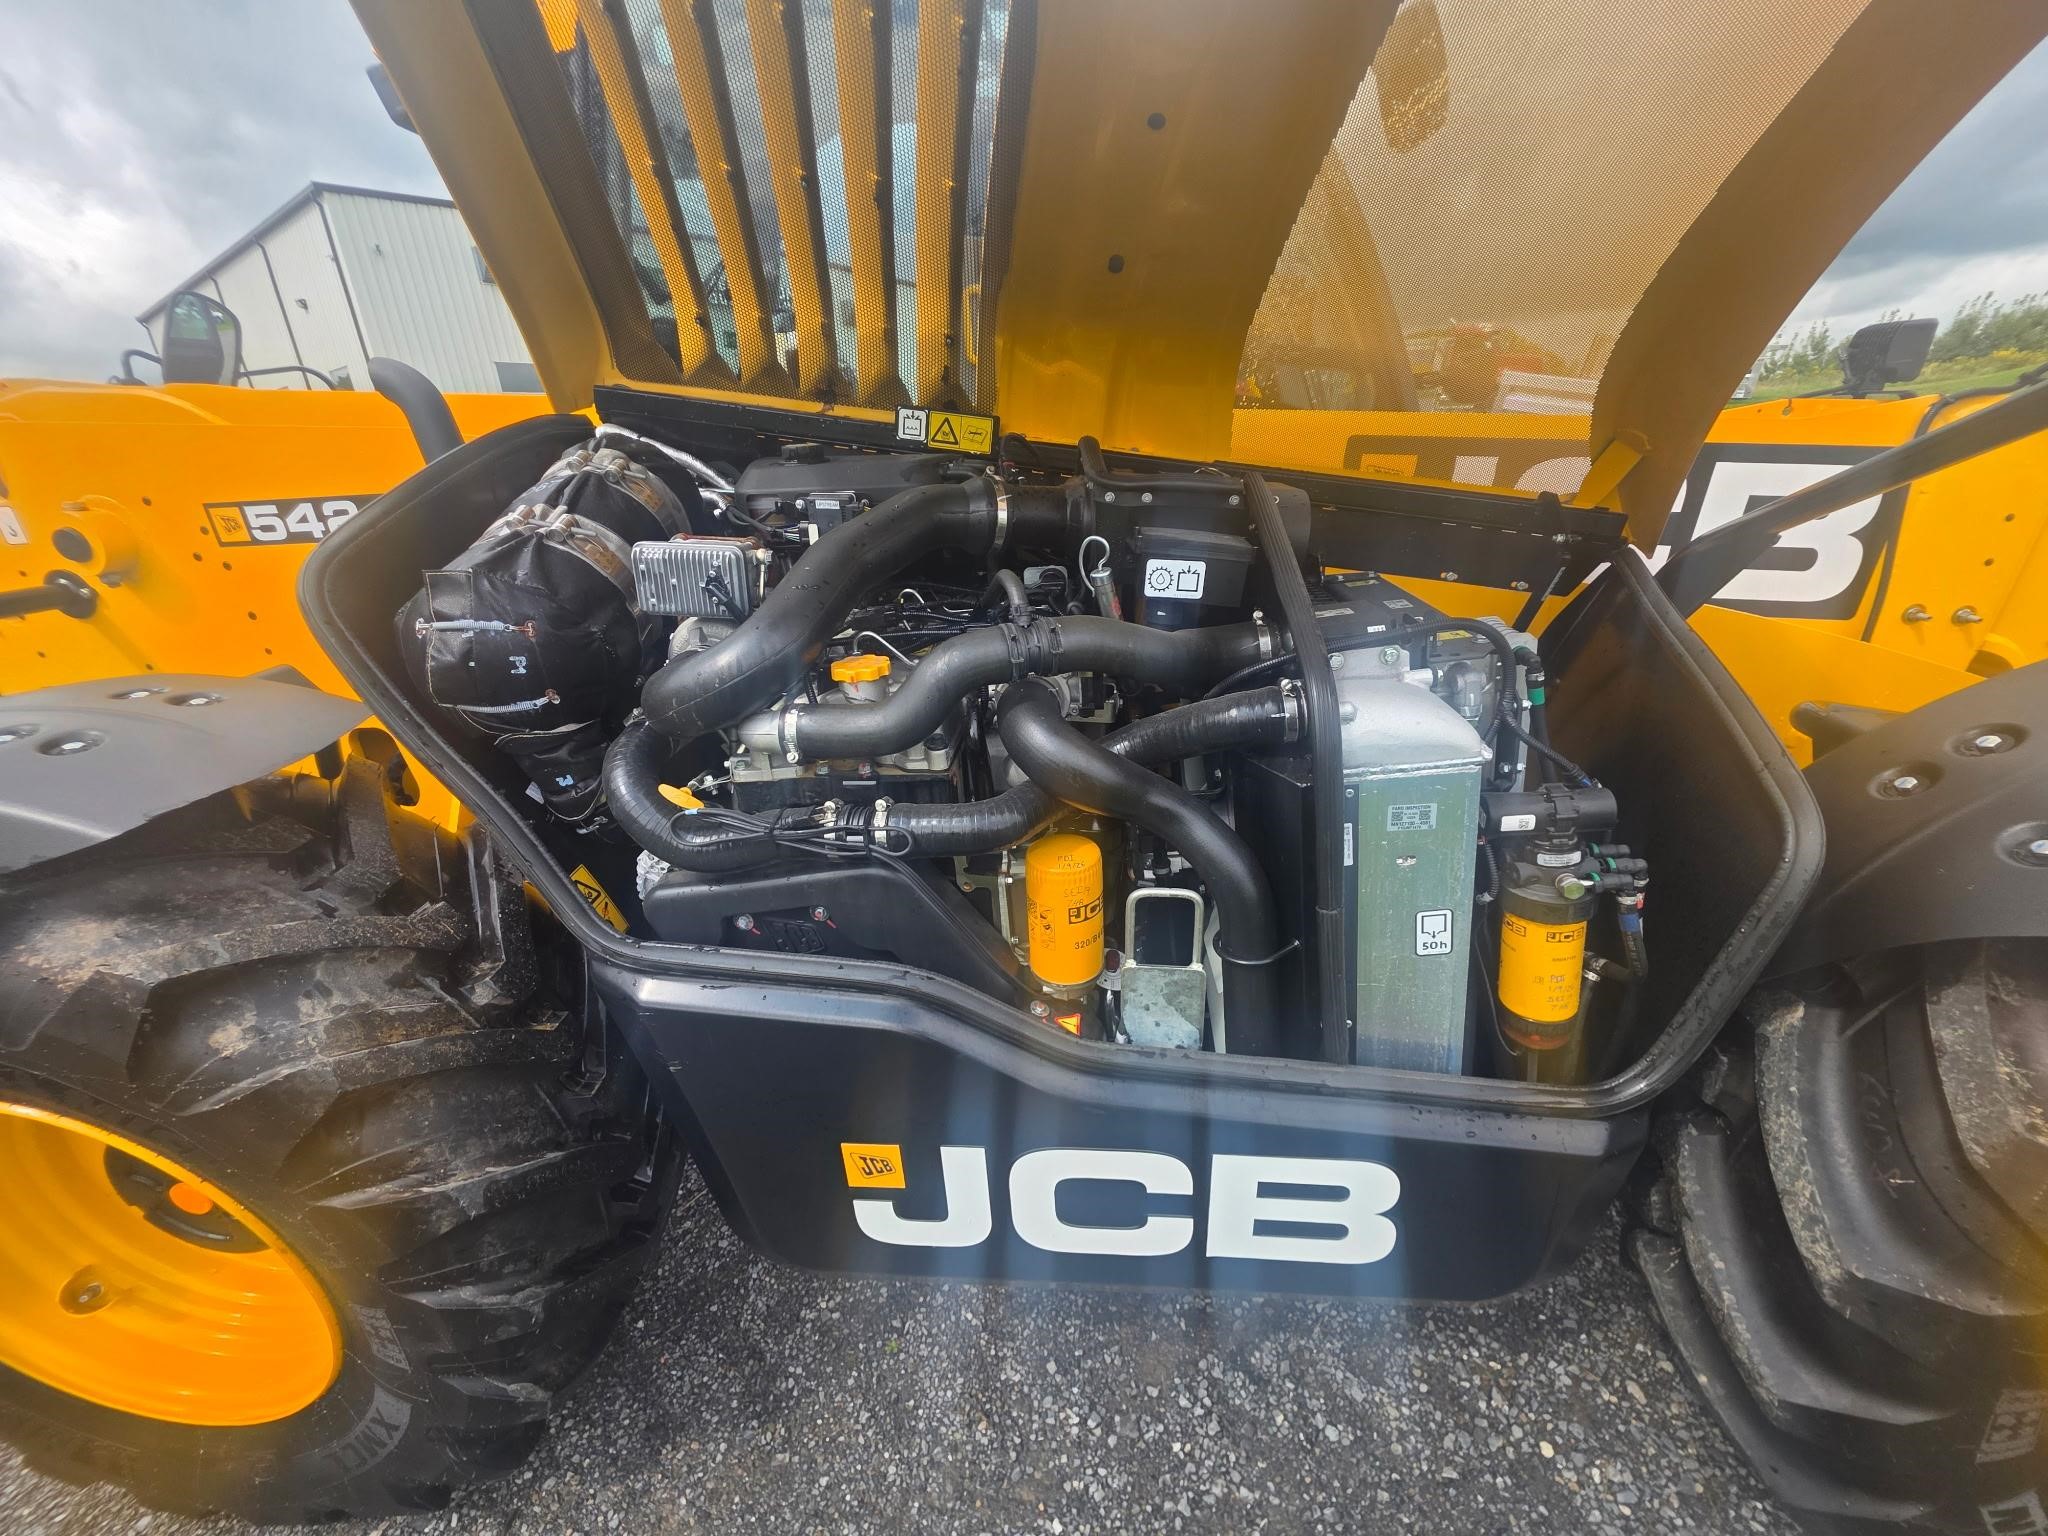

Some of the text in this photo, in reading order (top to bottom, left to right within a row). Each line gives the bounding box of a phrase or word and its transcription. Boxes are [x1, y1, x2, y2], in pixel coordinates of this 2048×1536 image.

[243, 501, 358, 541] 542
[1547, 927, 1584, 943] JCB
[859, 1156, 893, 1176] JCB
[852, 1145, 1401, 1264] JCB
